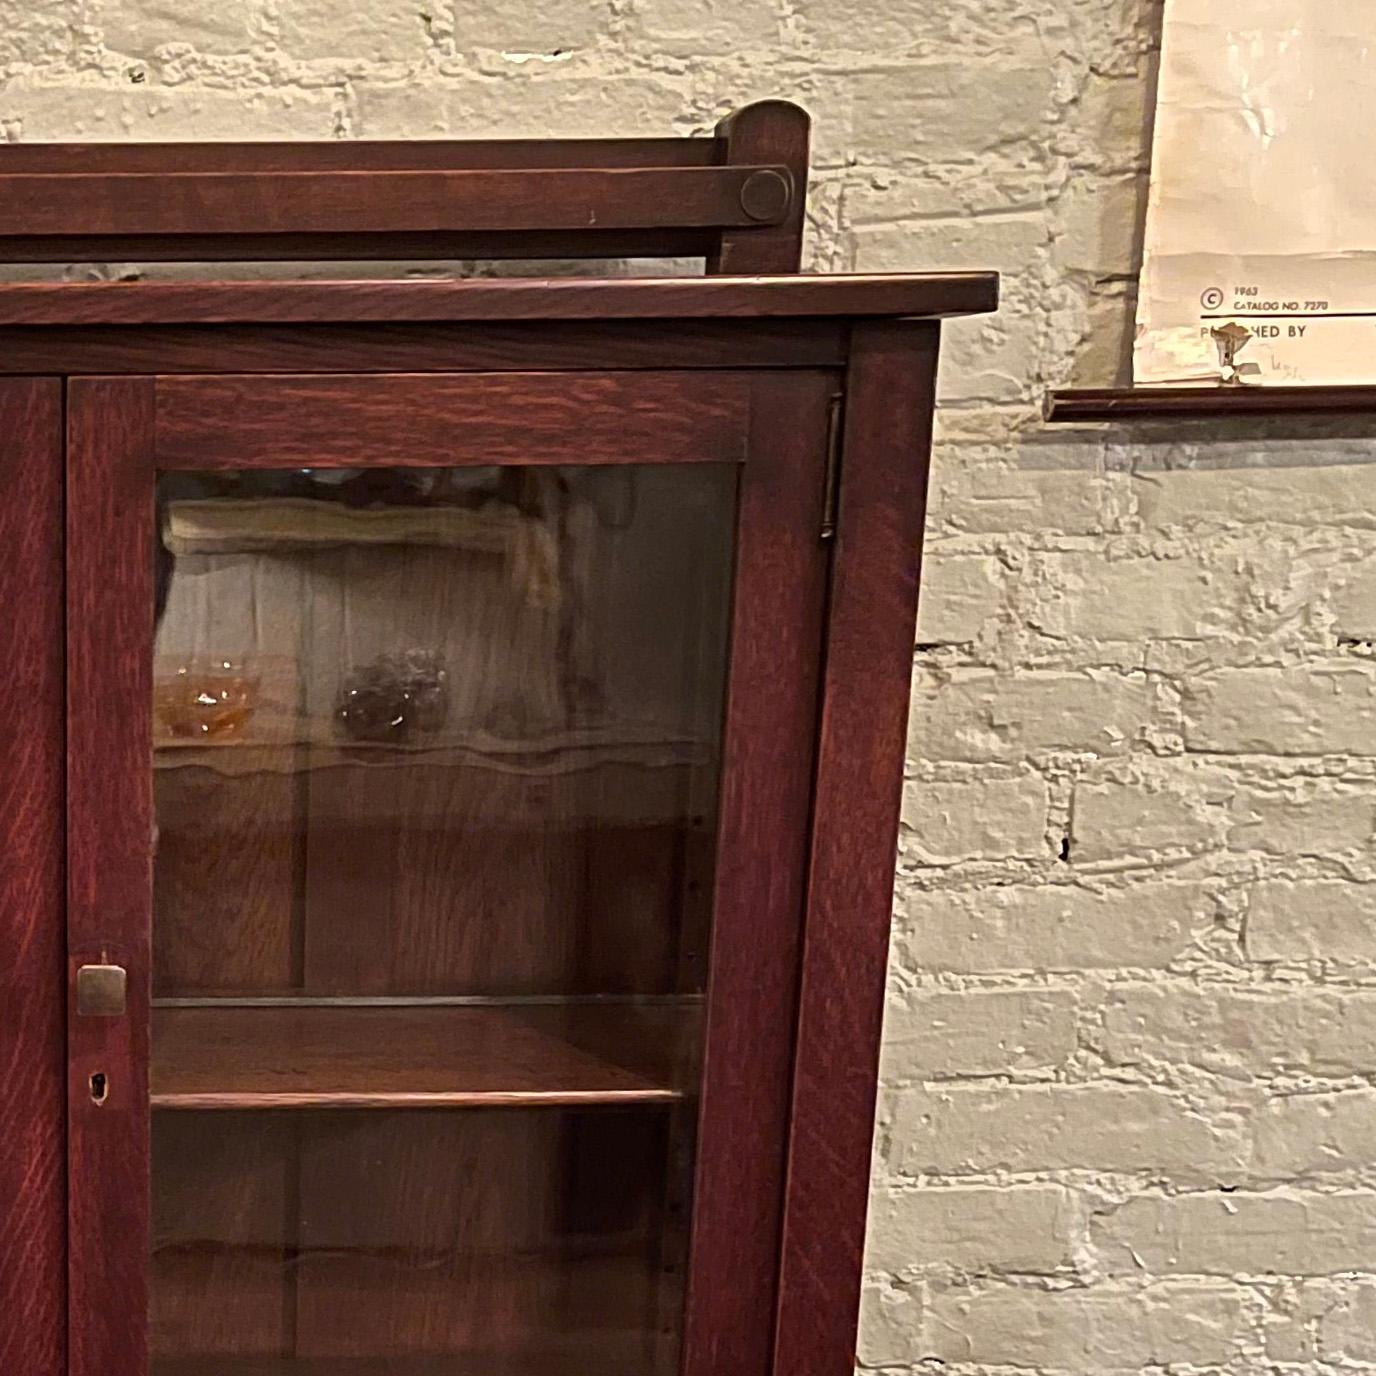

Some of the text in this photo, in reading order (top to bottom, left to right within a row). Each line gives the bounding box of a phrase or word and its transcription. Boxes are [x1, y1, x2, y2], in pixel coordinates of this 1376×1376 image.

[1234, 287, 1258, 296] 1963
[1233, 301, 1279, 311] CATALOG
[1288, 325, 1306, 337] BY
